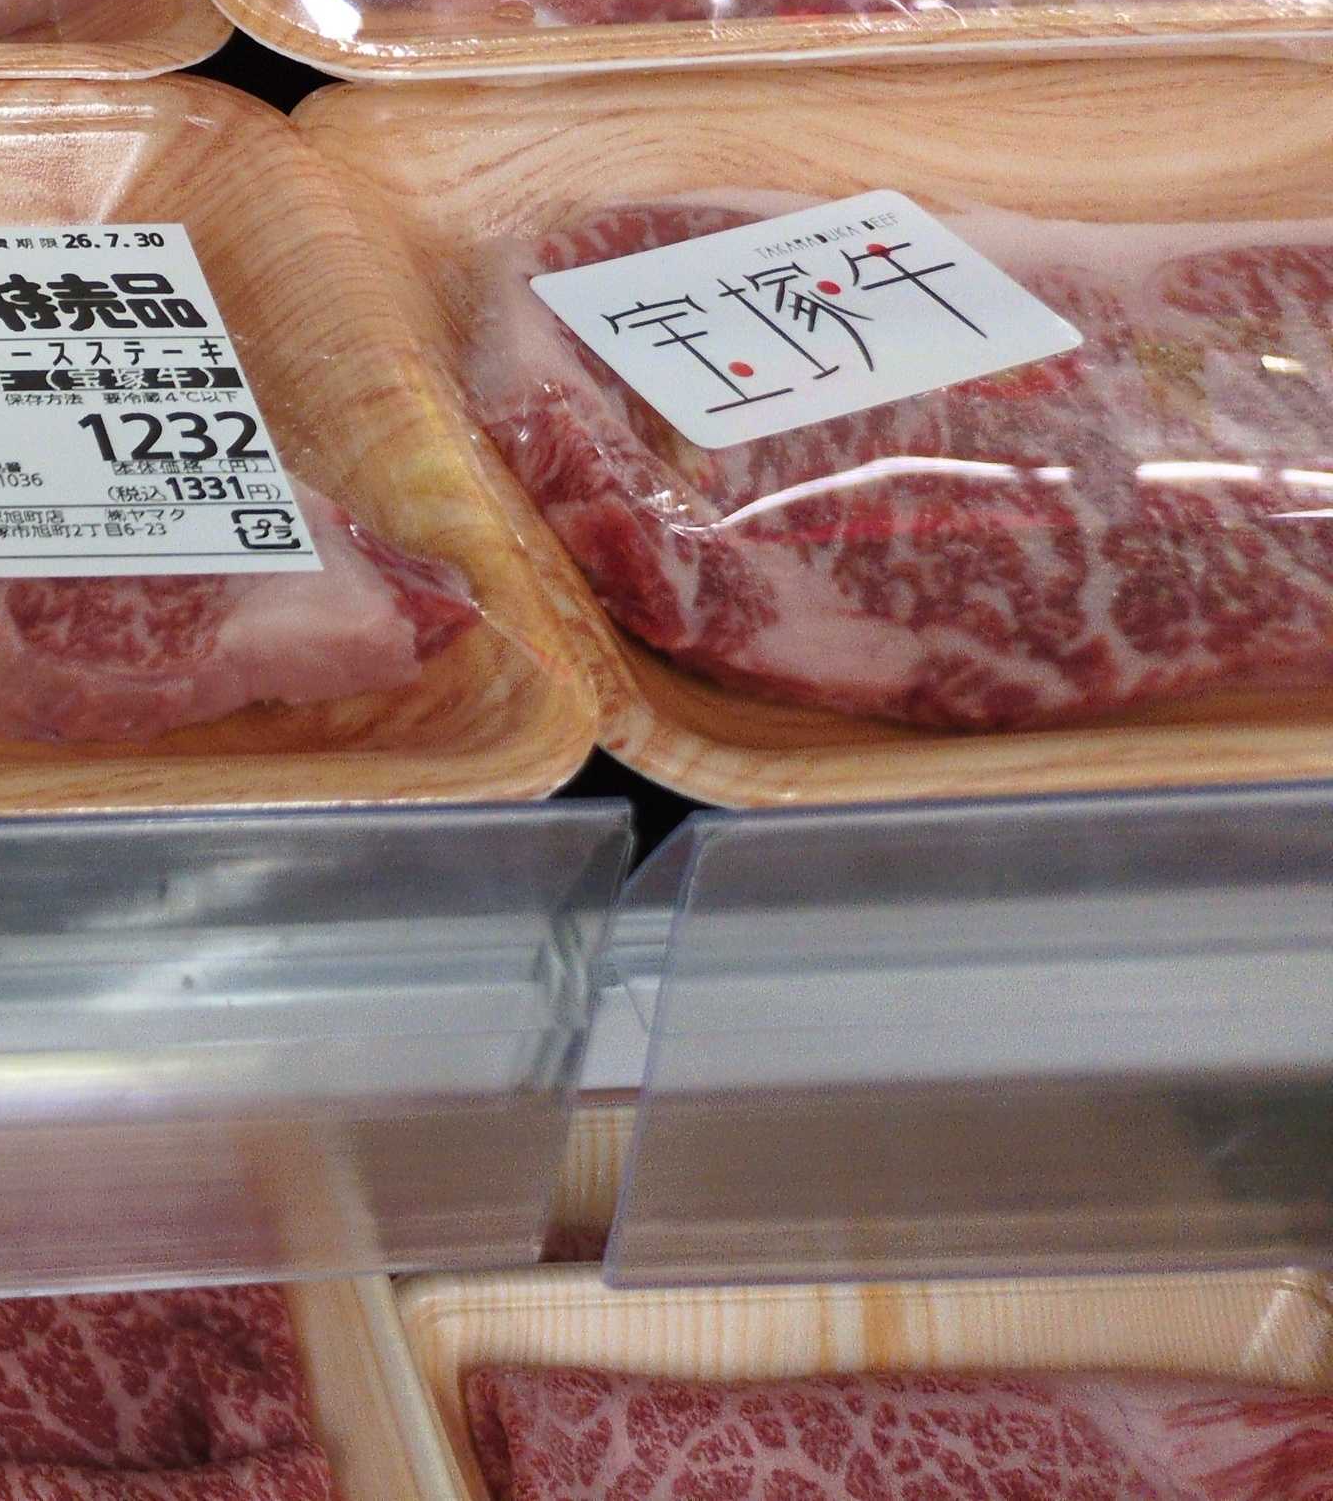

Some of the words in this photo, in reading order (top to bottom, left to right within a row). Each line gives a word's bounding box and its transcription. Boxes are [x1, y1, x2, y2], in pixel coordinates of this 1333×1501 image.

[62, 232, 165, 249] 26.7.30
[601, 242, 988, 414] 宝塚牛
[77, 410, 271, 462] 1232
